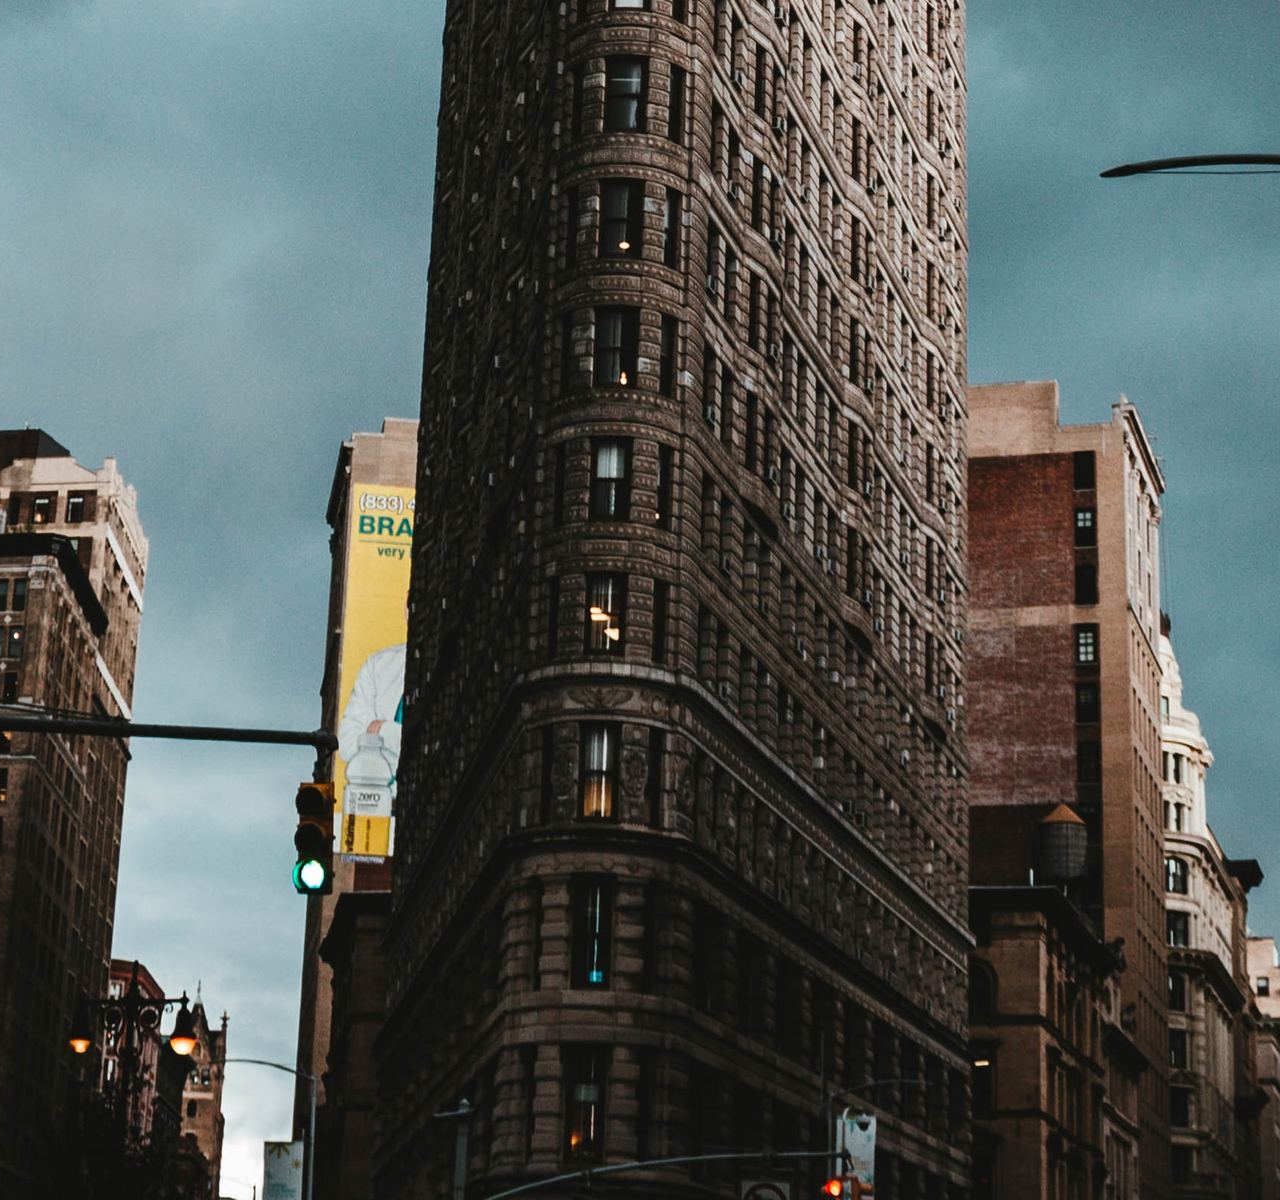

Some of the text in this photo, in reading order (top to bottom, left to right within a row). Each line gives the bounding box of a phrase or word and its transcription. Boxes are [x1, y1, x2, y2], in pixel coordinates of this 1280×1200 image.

[359, 514, 415, 537] BRA
[377, 547, 405, 560] very
[358, 792, 381, 802] zero
